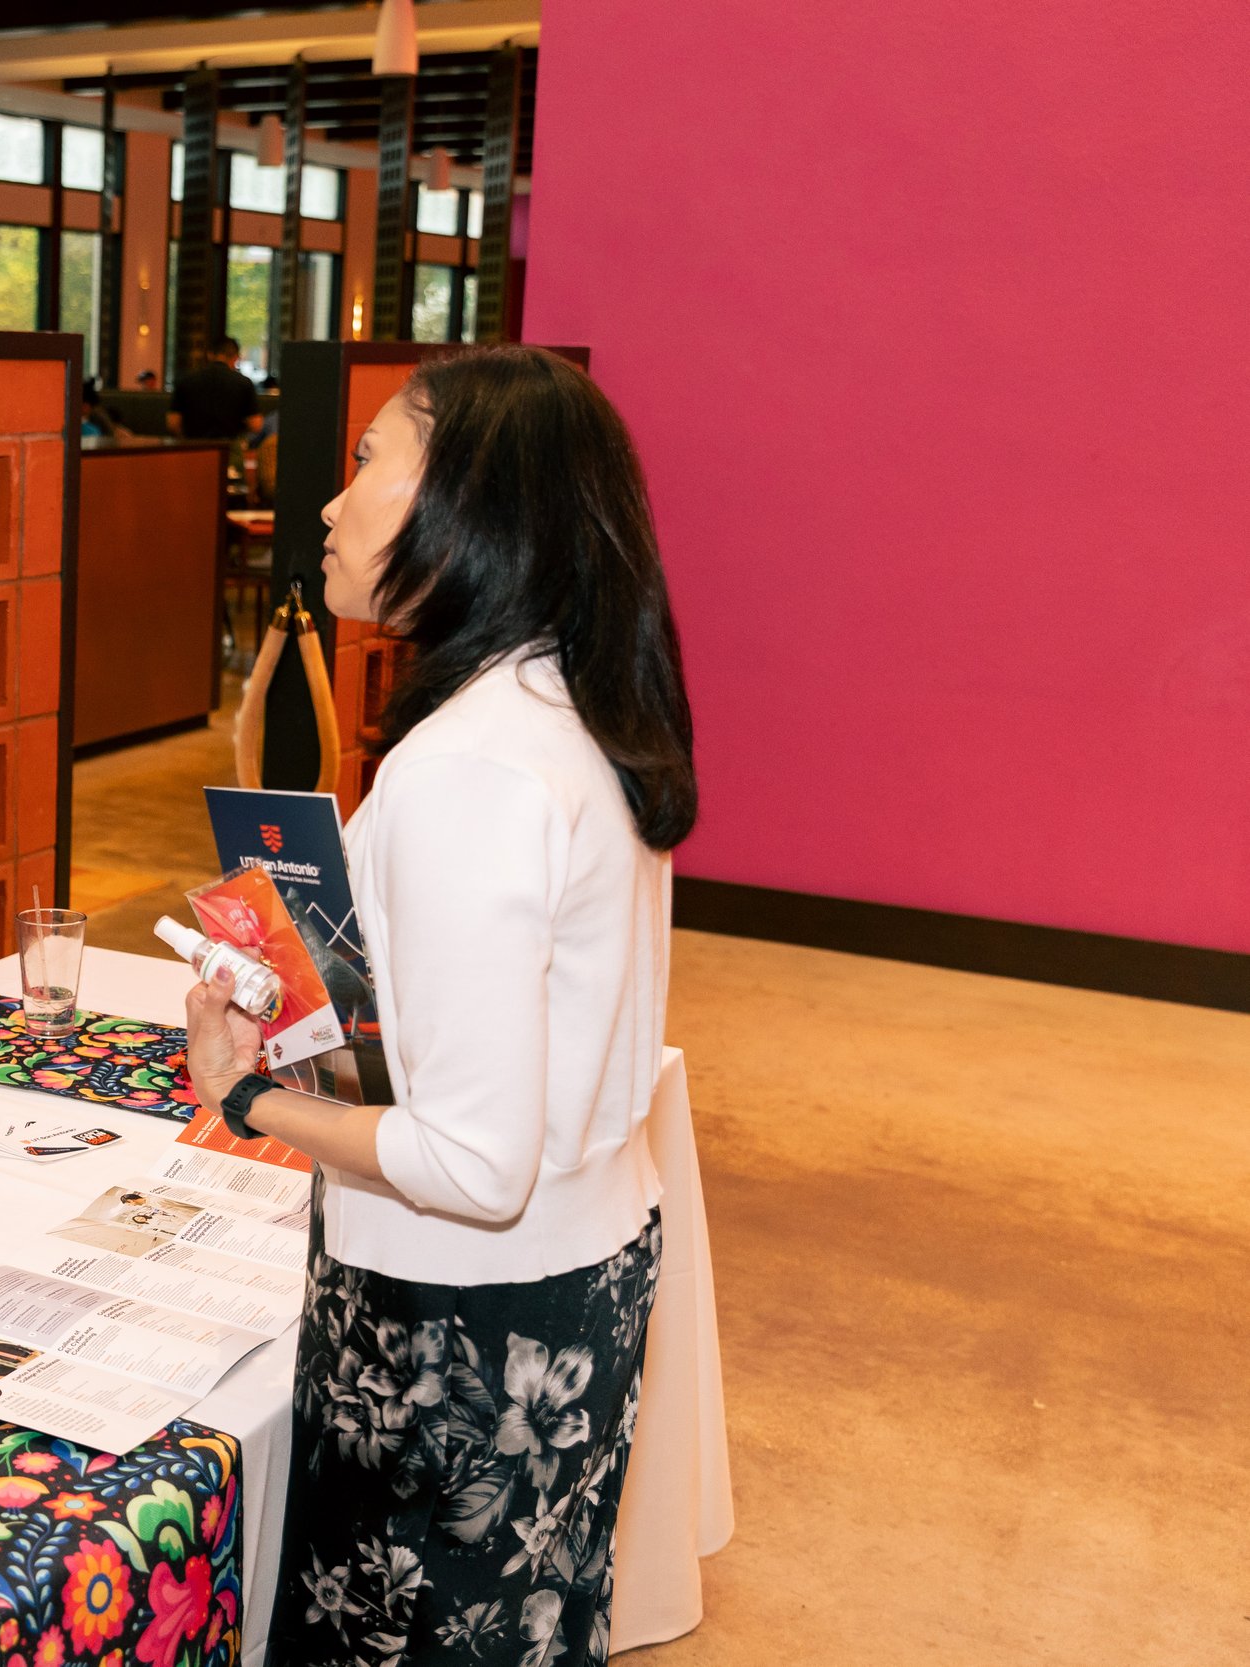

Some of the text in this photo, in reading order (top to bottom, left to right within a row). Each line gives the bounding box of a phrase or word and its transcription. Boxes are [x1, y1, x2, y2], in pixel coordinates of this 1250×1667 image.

[239, 856, 254, 868] UT
[254, 858, 276, 871] San
[277, 860, 319, 876] Antonio
